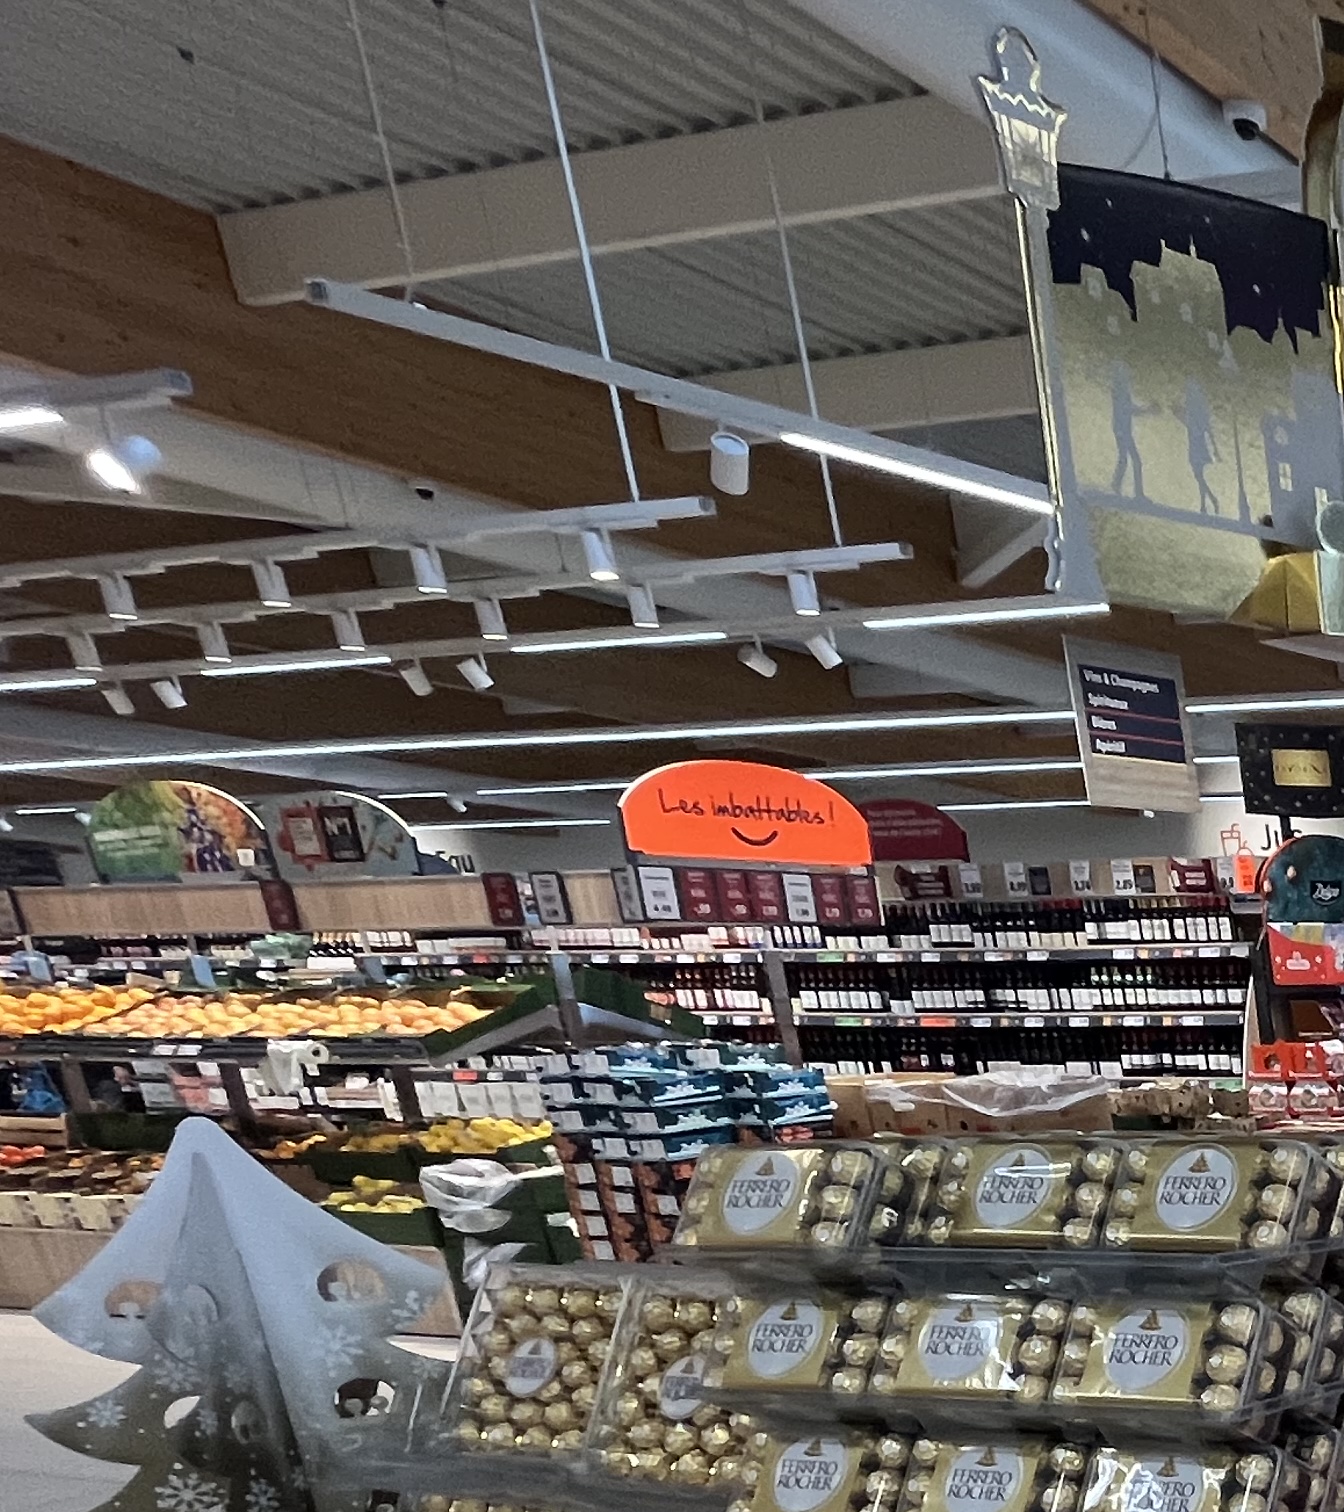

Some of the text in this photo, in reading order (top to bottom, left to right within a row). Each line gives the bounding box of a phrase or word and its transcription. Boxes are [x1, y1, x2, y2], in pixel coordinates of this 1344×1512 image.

[657, 787, 704, 816] Les
[730, 1178, 790, 1196] FERRERO
[1163, 1176, 1226, 1193] FERRERO
[726, 1191, 784, 1209] ROCHER
[1159, 1188, 1220, 1206] ROCHER
[755, 1323, 813, 1341] FERRERO
[752, 1335, 808, 1354] ROCHER
[1114, 1334, 1178, 1351] FERRERO
[1109, 1347, 1172, 1366] ROCHER
[781, 1458, 838, 1478] FERRERO
[776, 1471, 833, 1491] ROCHER
[952, 1469, 1012, 1487] FERRERO
[947, 1481, 1006, 1500] ROCHER
